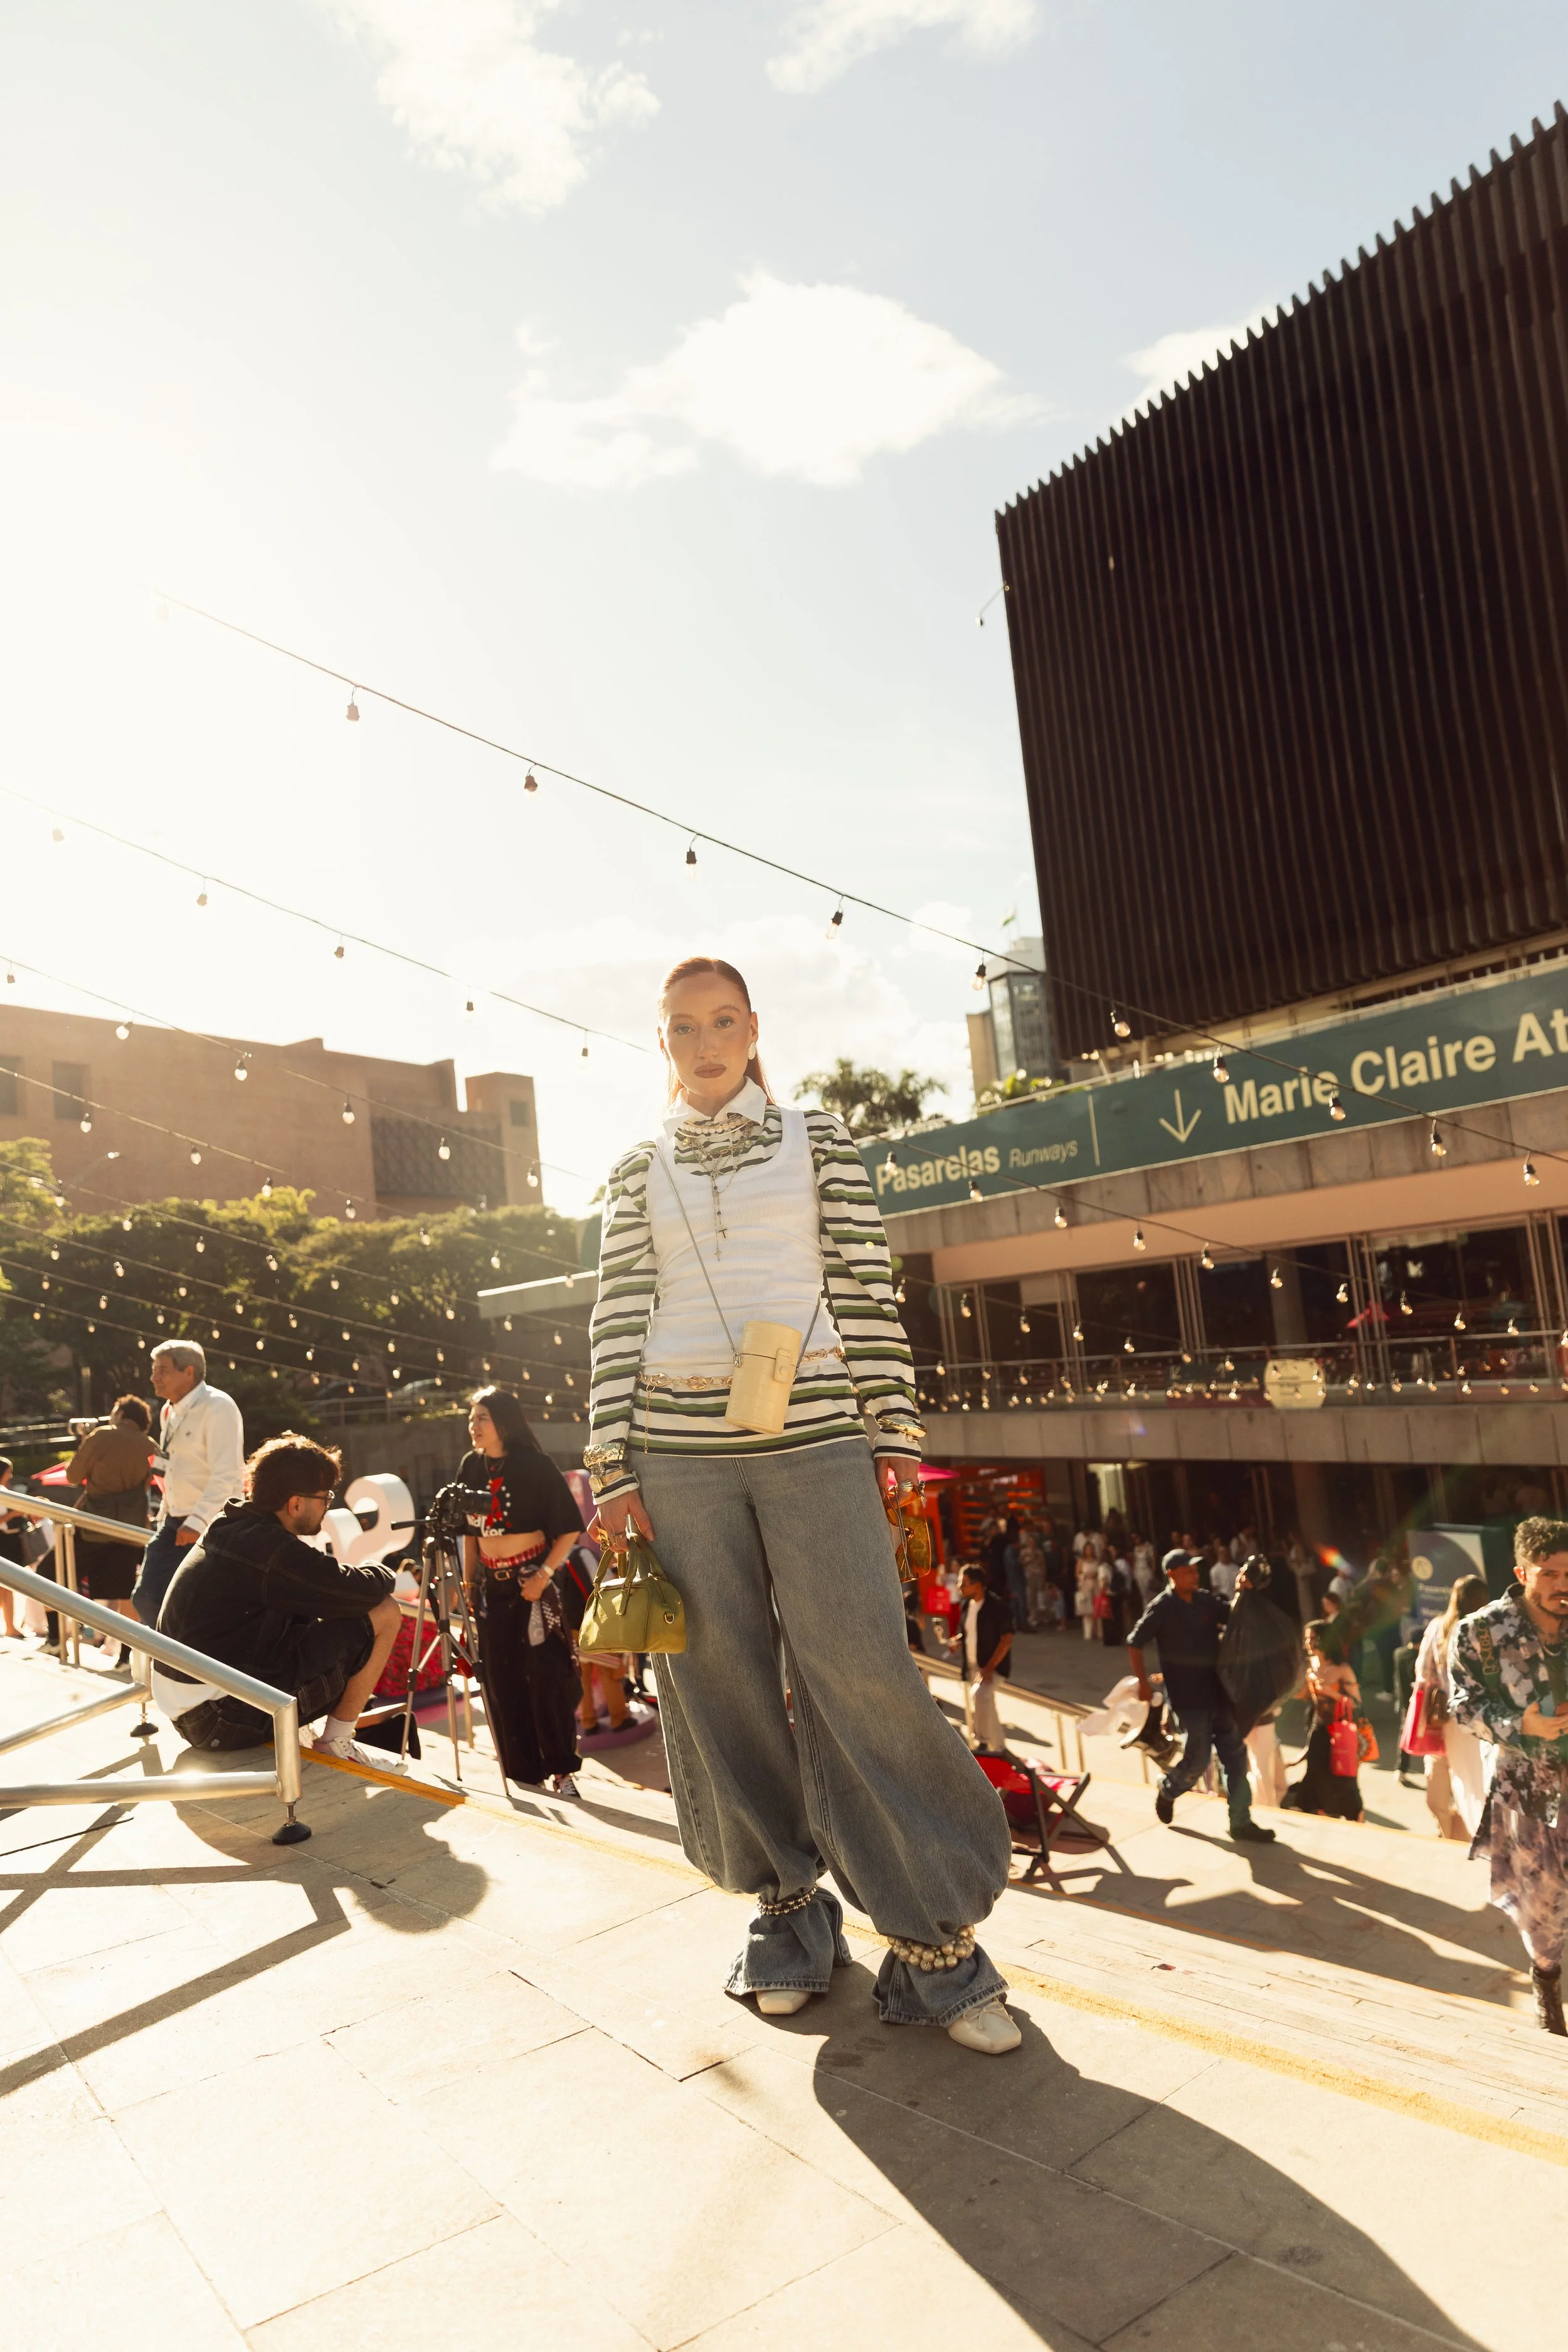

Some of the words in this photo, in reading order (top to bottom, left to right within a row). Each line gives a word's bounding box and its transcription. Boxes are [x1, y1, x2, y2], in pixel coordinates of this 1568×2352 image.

[1223, 1066, 1340, 1125] Marie
[1350, 1035, 1496, 1096] Claire
[1512, 1008, 1568, 1064] At
[875, 1145, 1001, 1195] Pasarelas
[1009, 1140, 1078, 1168] Runways
